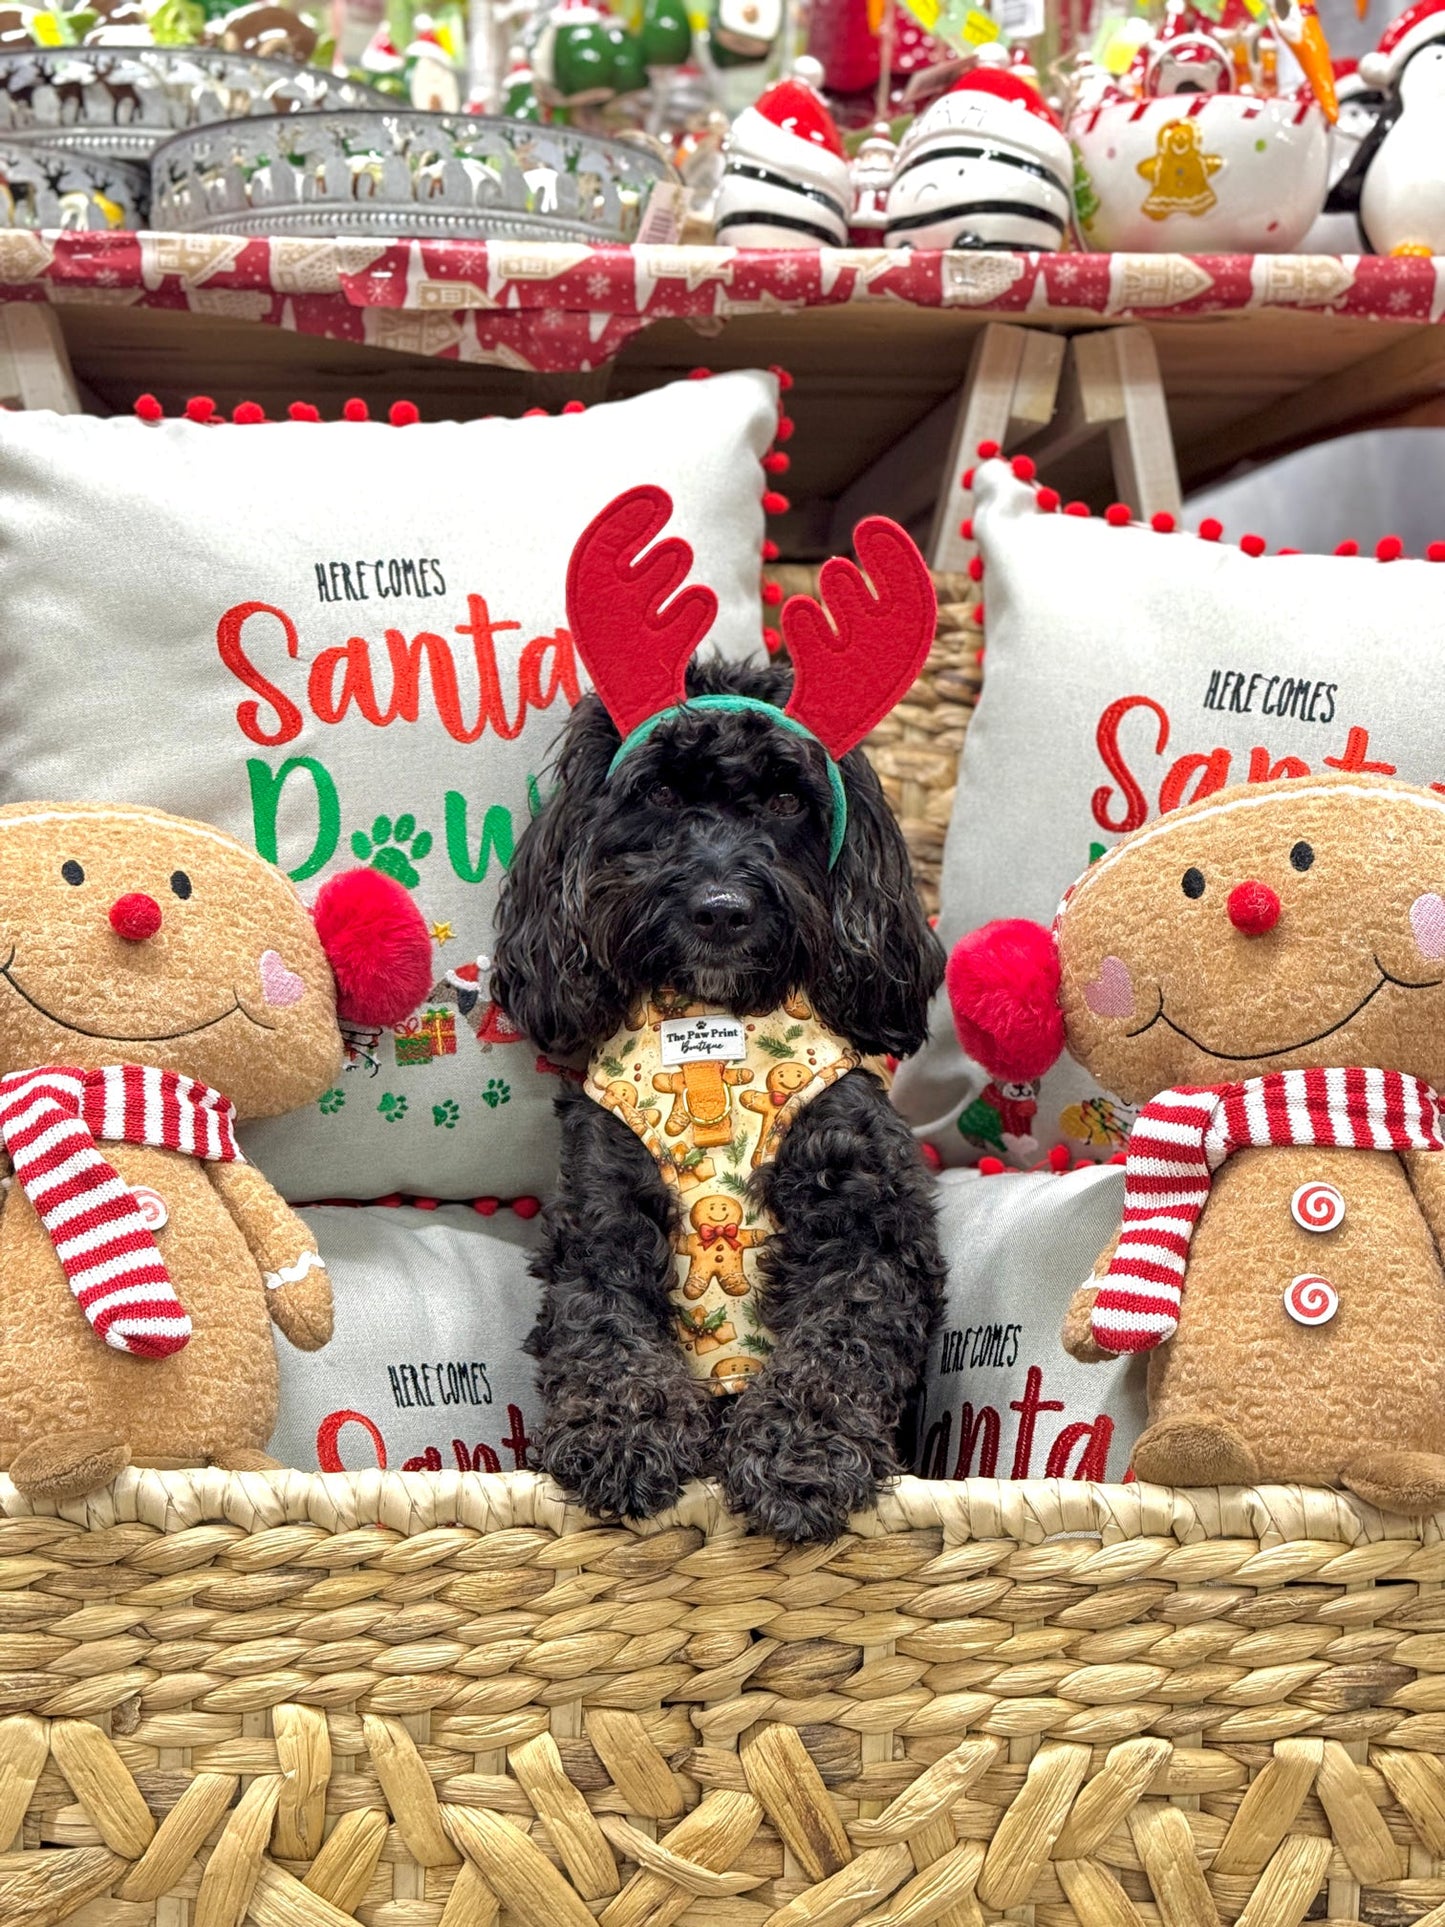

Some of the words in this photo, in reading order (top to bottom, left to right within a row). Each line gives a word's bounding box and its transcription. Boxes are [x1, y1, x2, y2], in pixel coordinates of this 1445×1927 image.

[315, 560, 369, 602] HERE
[375, 557, 447, 599] COMES
[216, 593, 581, 747] Santa
[1203, 669, 1262, 713] HERE
[1262, 675, 1338, 723] COMES
[1091, 695, 1445, 833] Sat
[666, 1032, 686, 1043] The
[687, 1029, 709, 1040] Paw
[711, 1027, 739, 1038] Print
[681, 1040, 724, 1054] Boutique
[940, 1328, 973, 1376] HERE
[970, 1322, 1022, 1369] COMES
[388, 1363, 436, 1408] HERE
[436, 1361, 493, 1406] COMES
[921, 1365, 1135, 1483] anta
